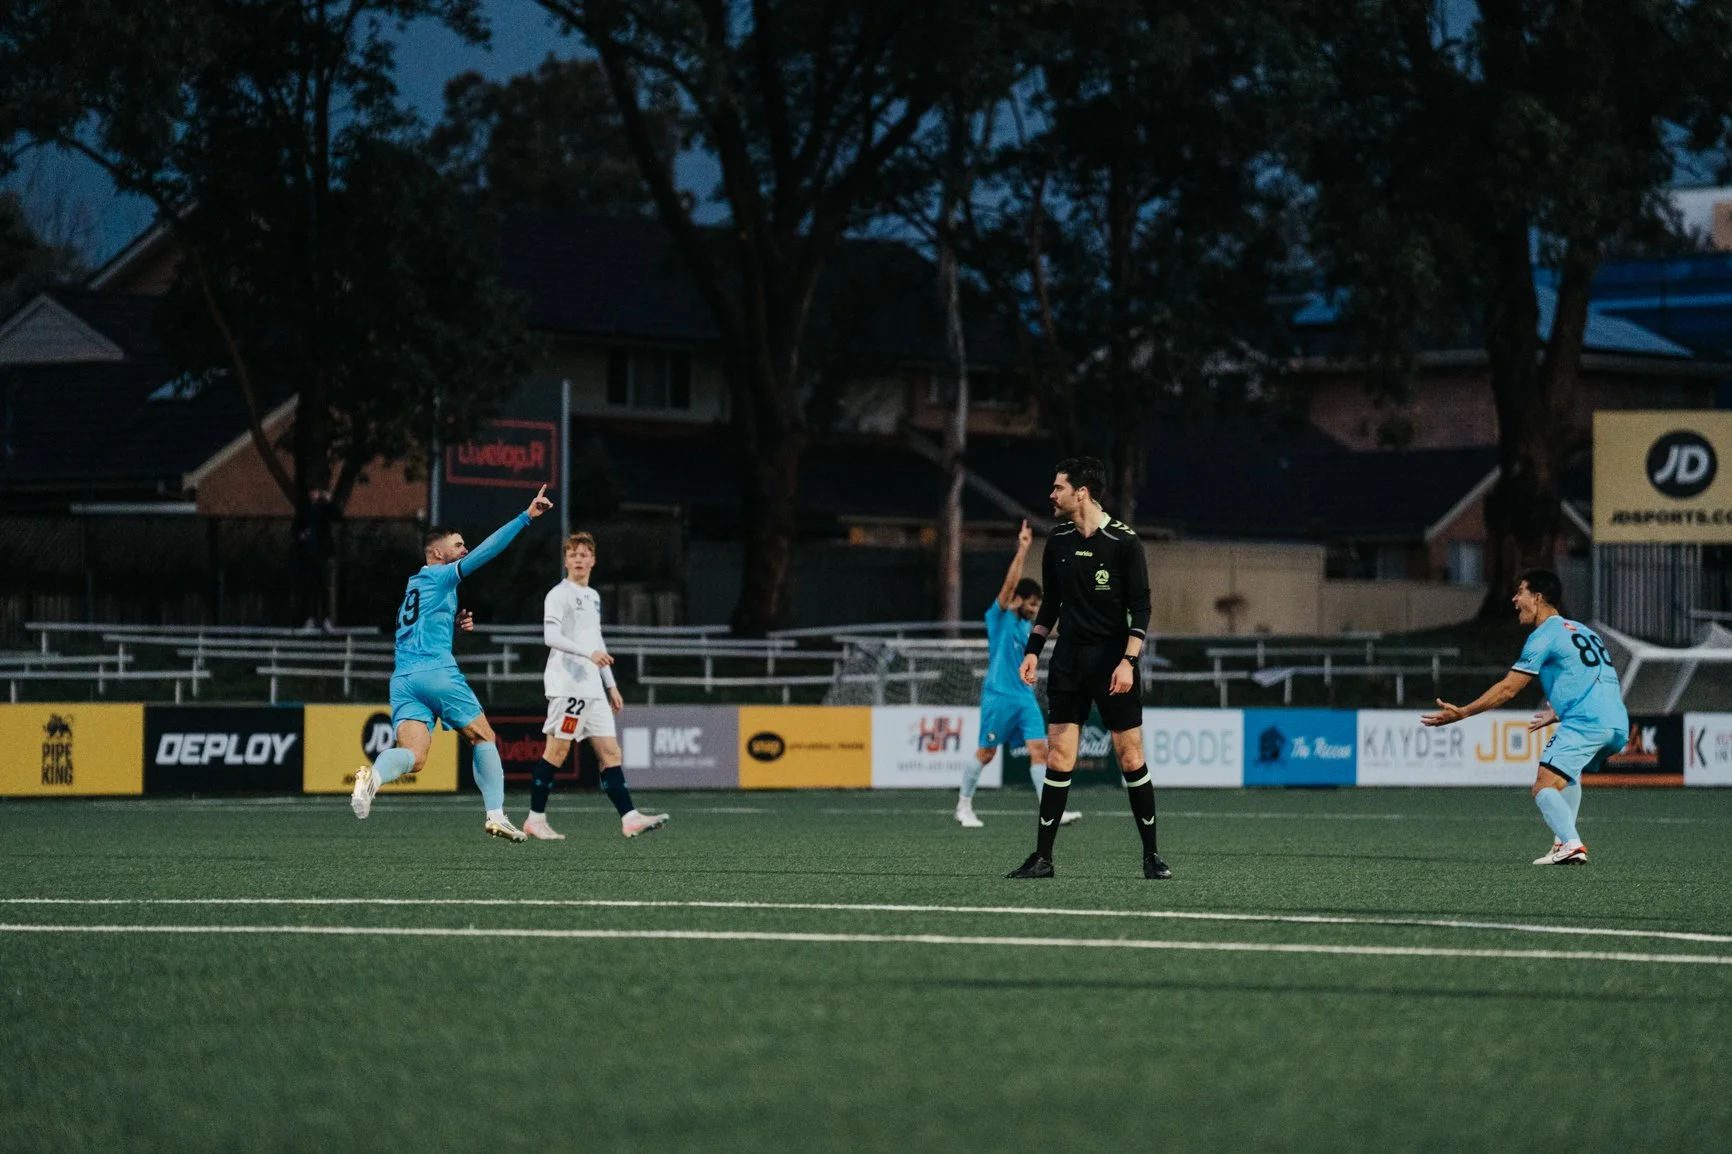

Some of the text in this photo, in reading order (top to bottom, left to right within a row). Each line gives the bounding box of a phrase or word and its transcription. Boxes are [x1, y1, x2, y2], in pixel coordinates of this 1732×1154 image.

[1653, 444, 1710, 485] JD
[565, 697, 585, 716] 22
[42, 743, 73, 761] PIPE
[156, 732, 296, 766] DEPLOY
[365, 722, 395, 753] JD
[654, 727, 703, 755] RWC
[1363, 725, 1465, 760] KAYDER
[41, 765, 73, 786] KING
